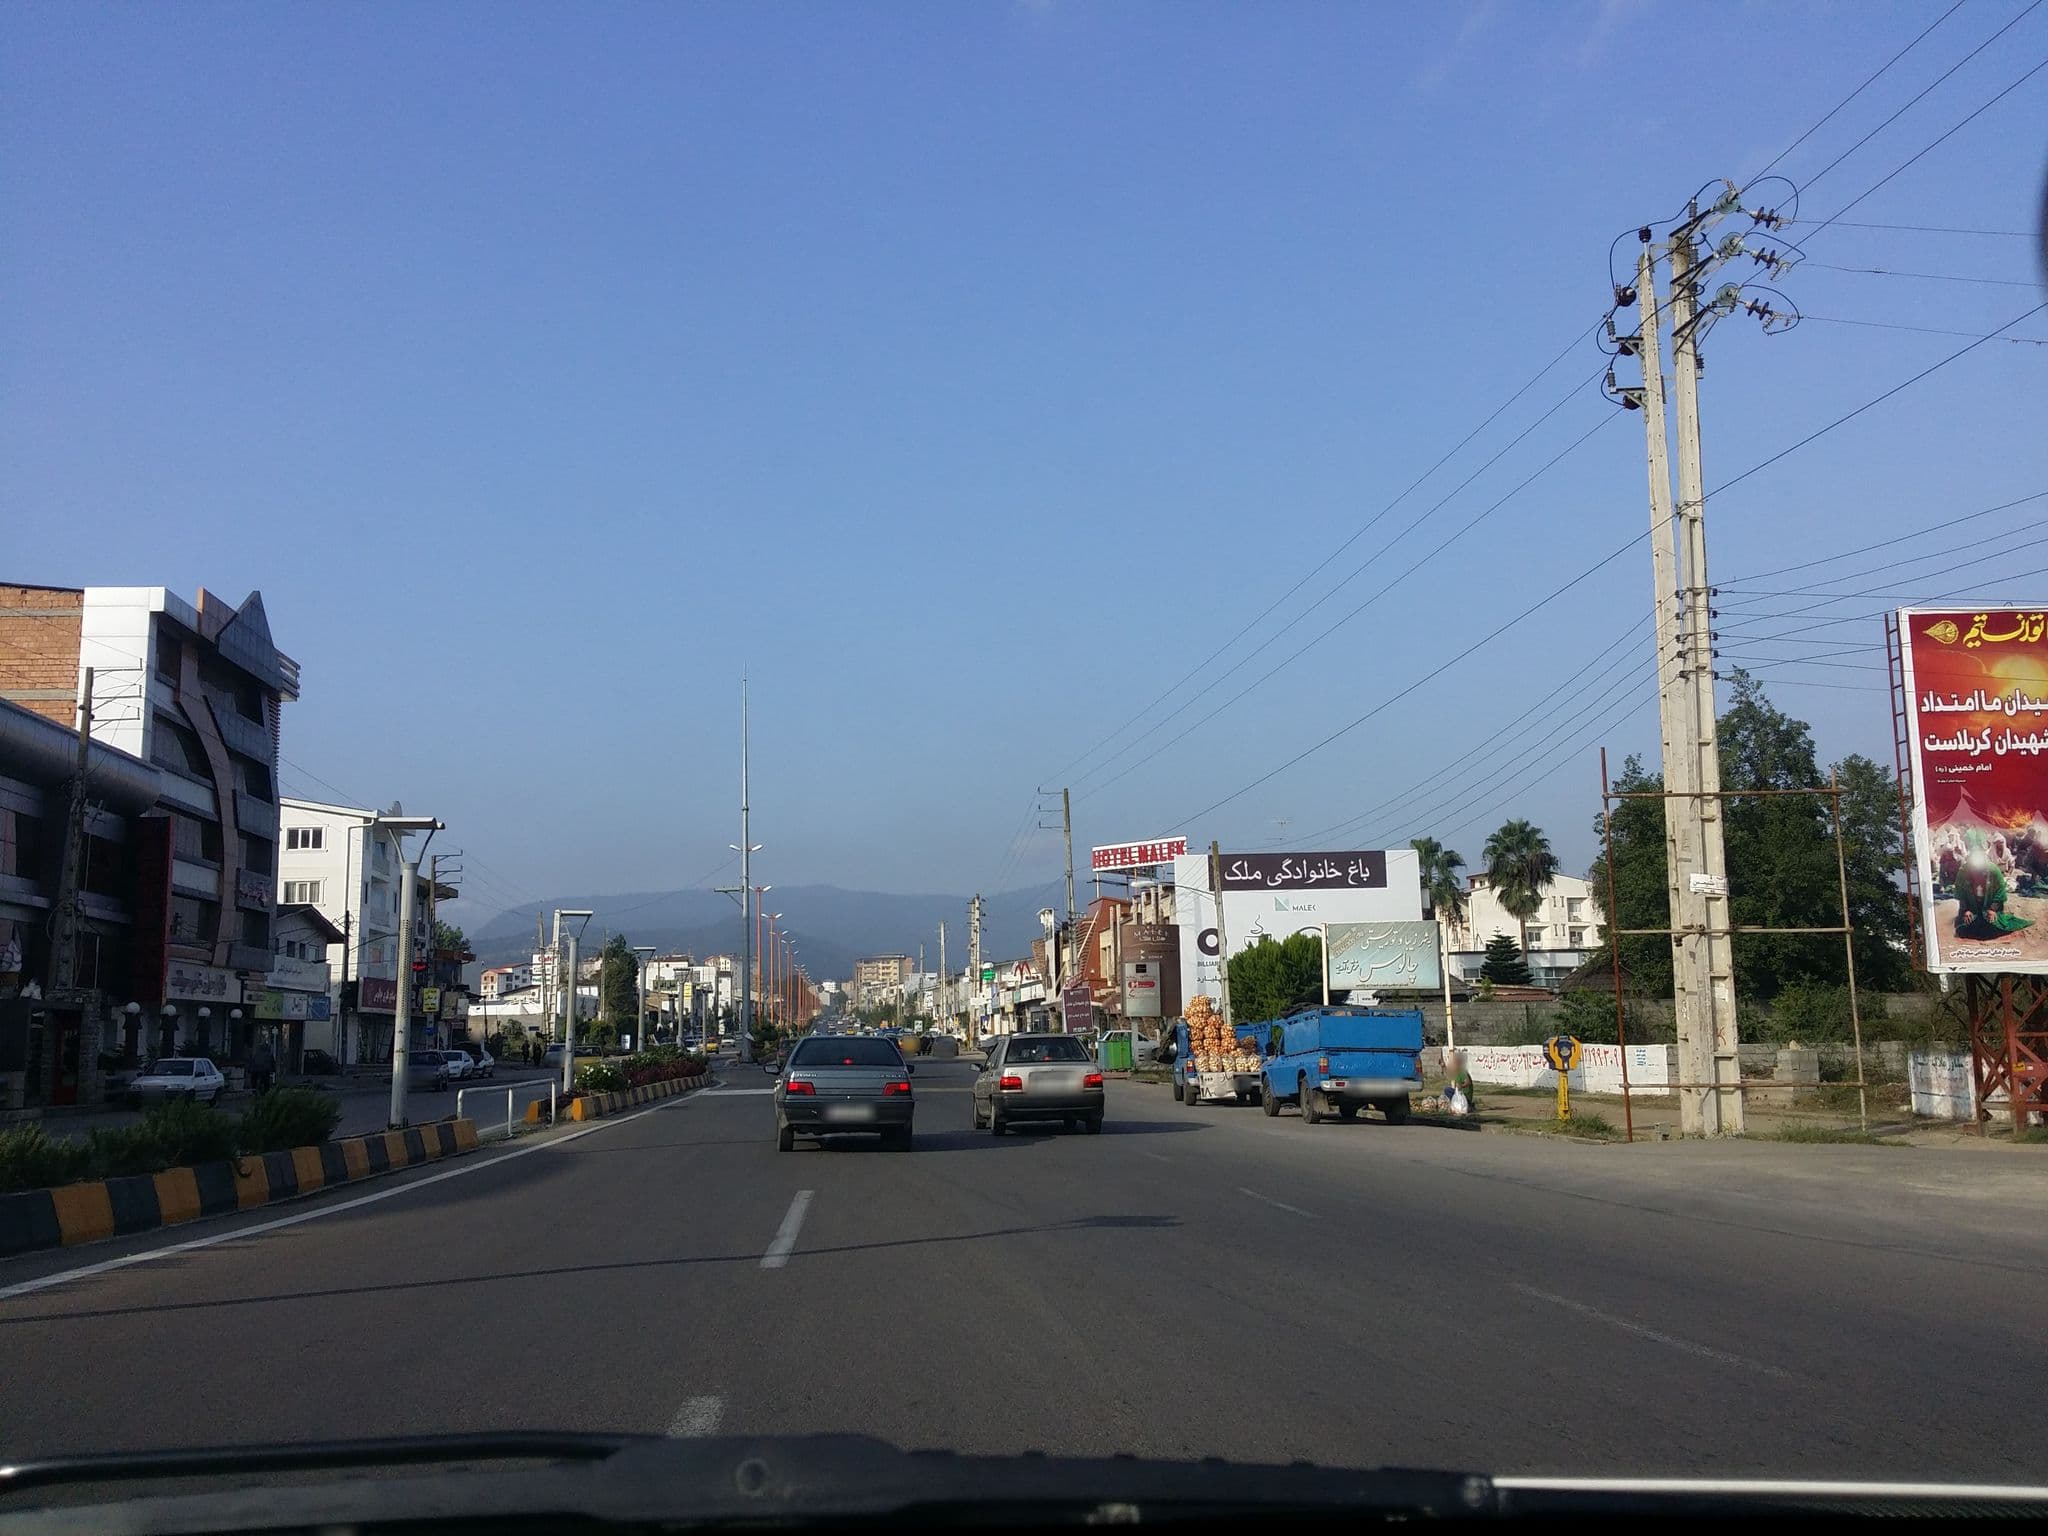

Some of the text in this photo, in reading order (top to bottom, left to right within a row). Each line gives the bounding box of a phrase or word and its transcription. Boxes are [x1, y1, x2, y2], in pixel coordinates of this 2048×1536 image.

[1920, 688, 2048, 716] یدان ما امتداد
[1924, 727, 1992, 757] کربلاست
[1948, 763, 1975, 774] خمینی
[1975, 763, 1992, 773] امام
[1092, 840, 1185, 869] HOTEL MALEK
[1224, 857, 1370, 887] باغ خانوادگی ملک
[1359, 950, 1418, 984] چالوس
